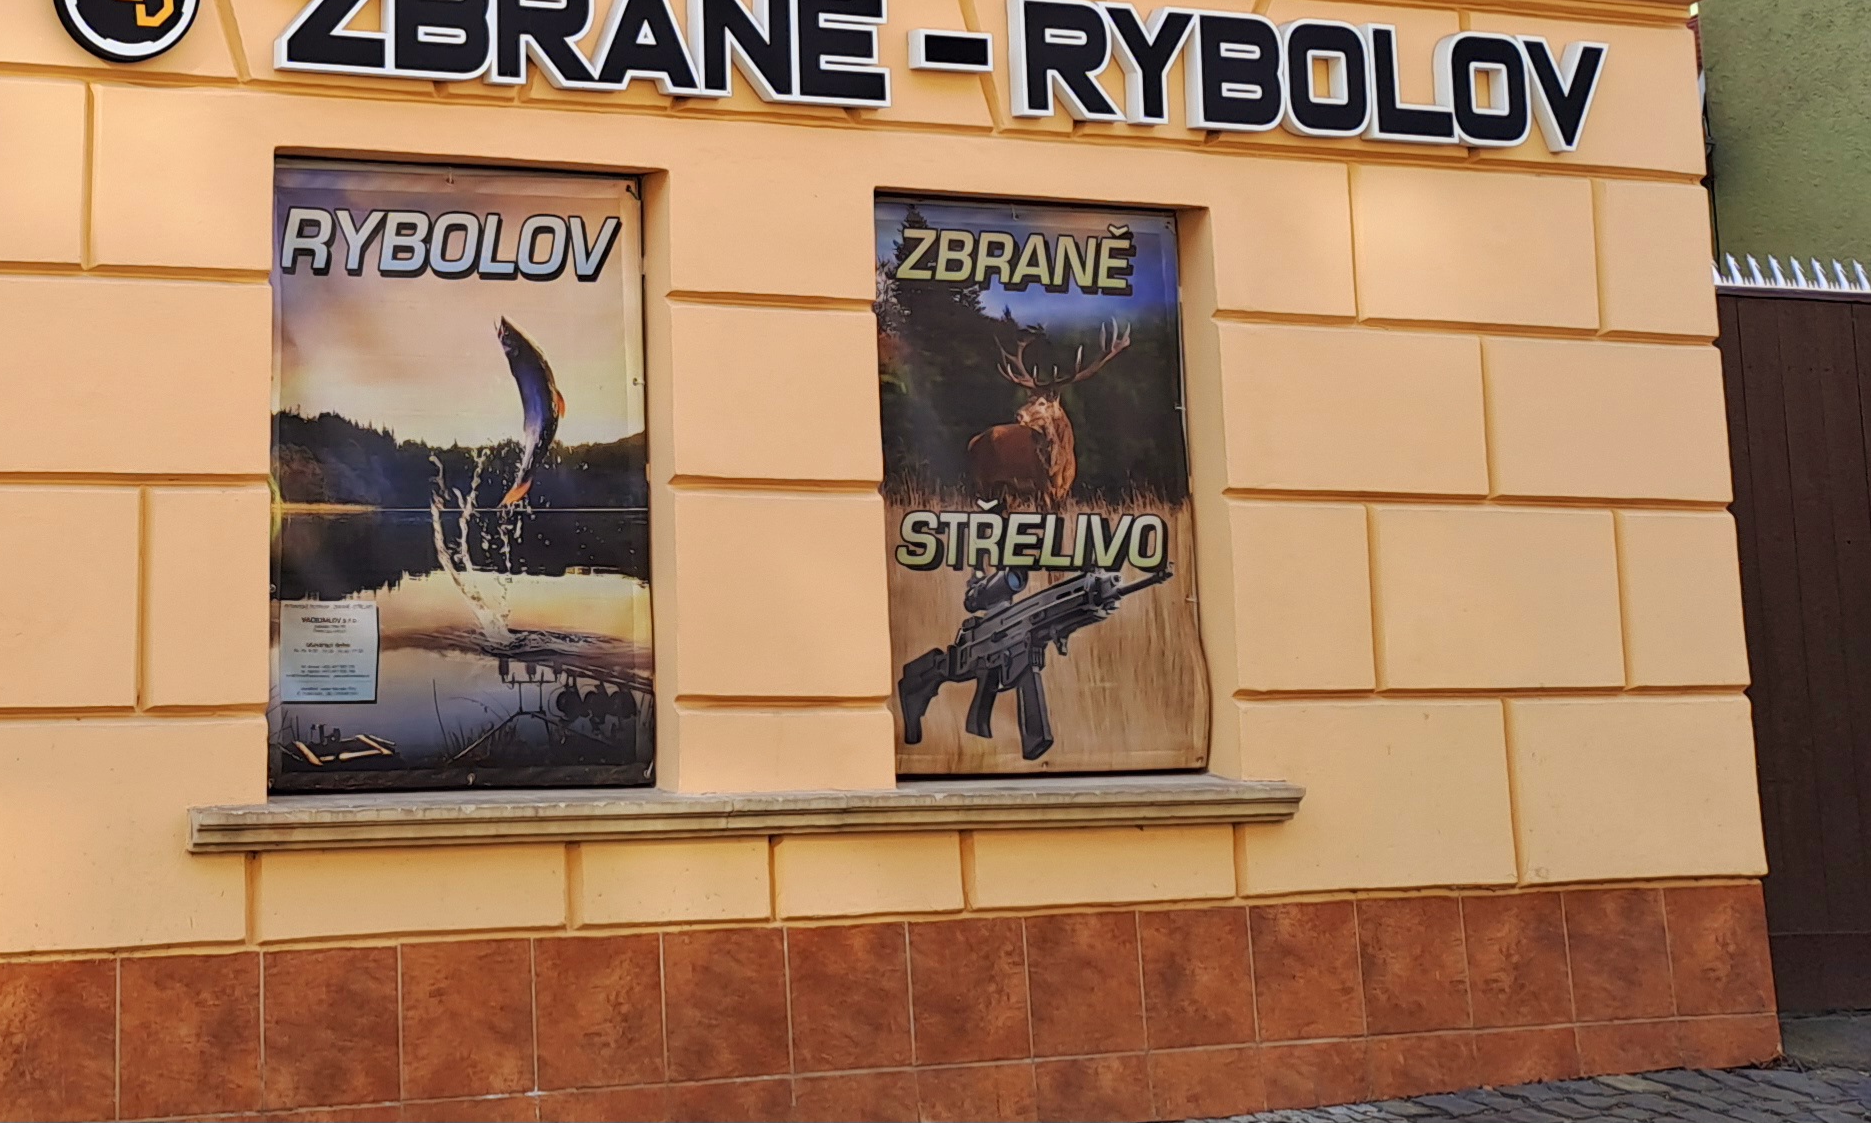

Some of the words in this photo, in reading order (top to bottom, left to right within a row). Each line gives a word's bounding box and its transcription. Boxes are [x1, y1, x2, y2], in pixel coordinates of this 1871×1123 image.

[908, 28, 994, 73] -
[280, 206, 622, 281] RYBOLOV
[896, 224, 1136, 295] ZBRANĚ
[895, 499, 1168, 573] STŘELIVO
